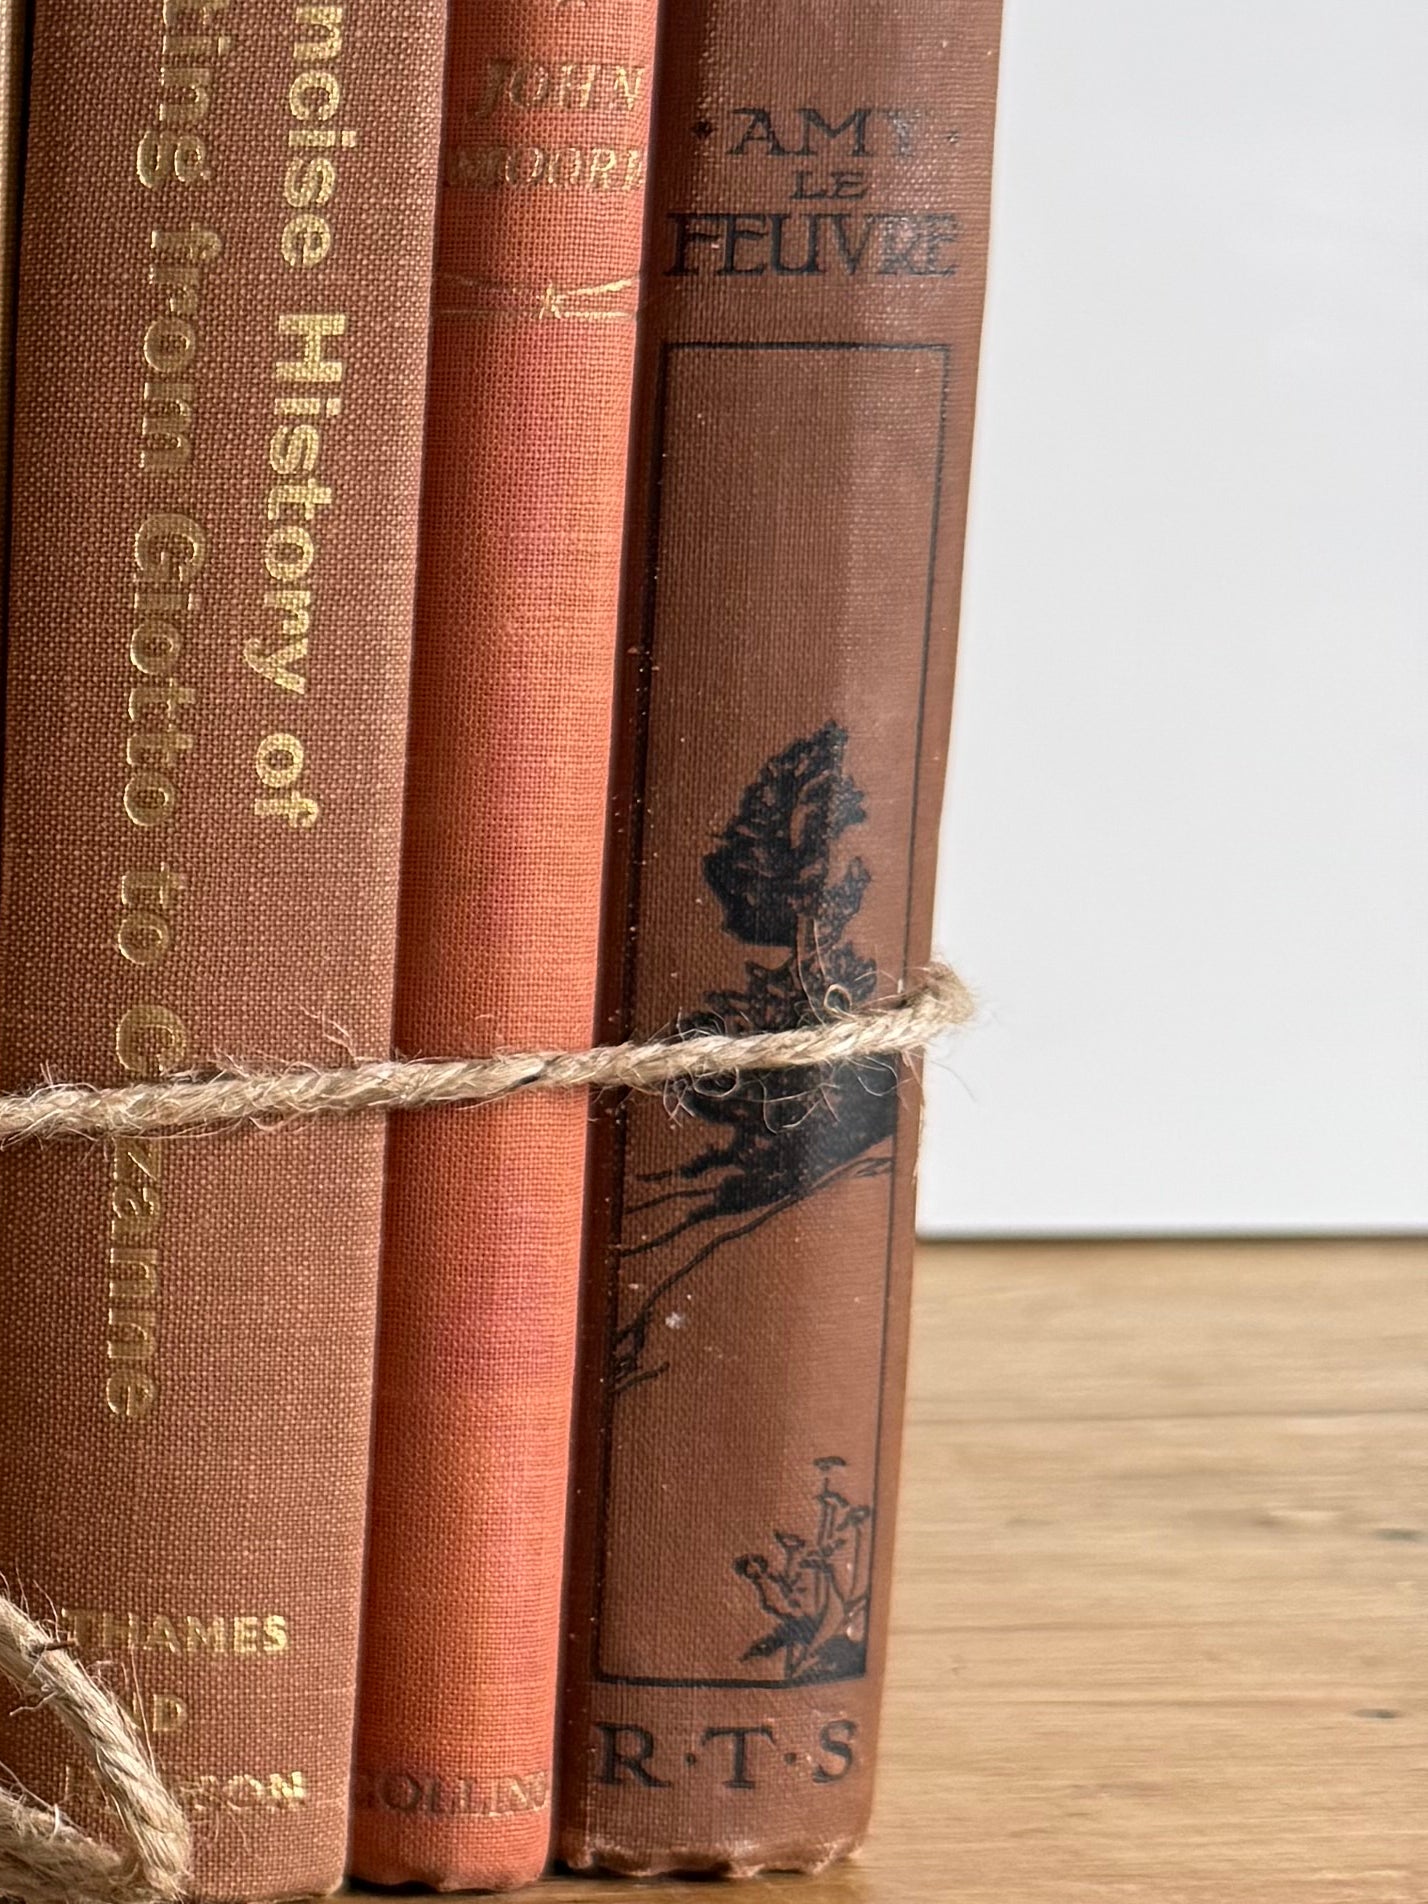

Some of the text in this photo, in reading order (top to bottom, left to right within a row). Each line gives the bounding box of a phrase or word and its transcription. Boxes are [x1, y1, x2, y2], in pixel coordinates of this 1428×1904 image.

[465, 58, 645, 126] JOHN
[448, 145, 645, 192] MOORE
[790, 166, 868, 201] LE
[662, 210, 961, 280] FEUVRE
[140, 223, 225, 470] from
[243, 313, 347, 696] History
[122, 512, 207, 828] Giotto
[253, 732, 321, 829] of
[116, 861, 187, 966] to
[105, 1003, 188, 1418] Czanne
[61, 1607, 290, 1654] THAMES
